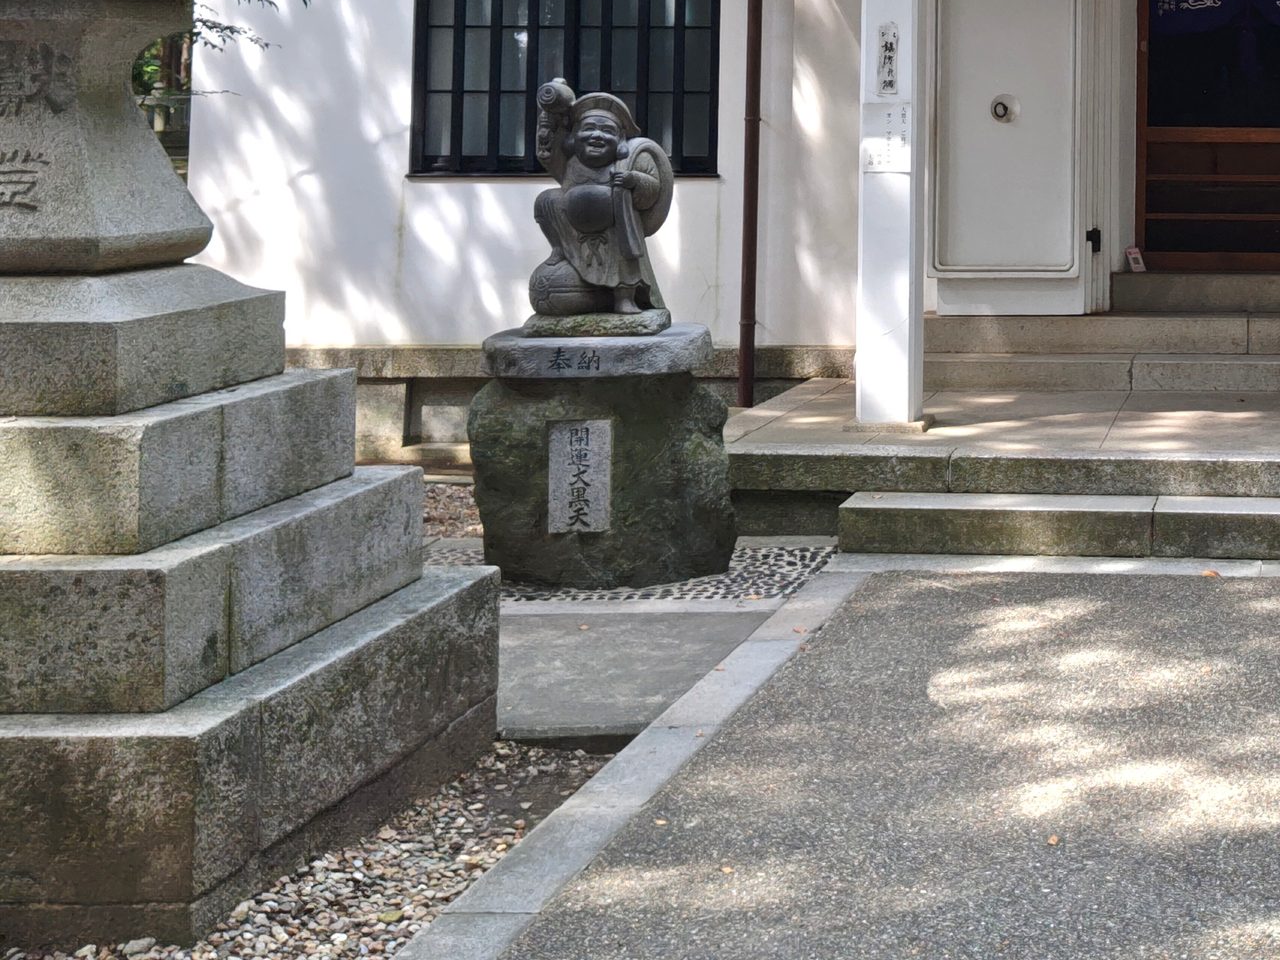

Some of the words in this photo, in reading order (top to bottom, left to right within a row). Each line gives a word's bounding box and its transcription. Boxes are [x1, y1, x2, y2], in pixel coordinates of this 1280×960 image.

[548, 348, 600, 372] 奉納
[568, 427, 591, 528] 開運大黒天
